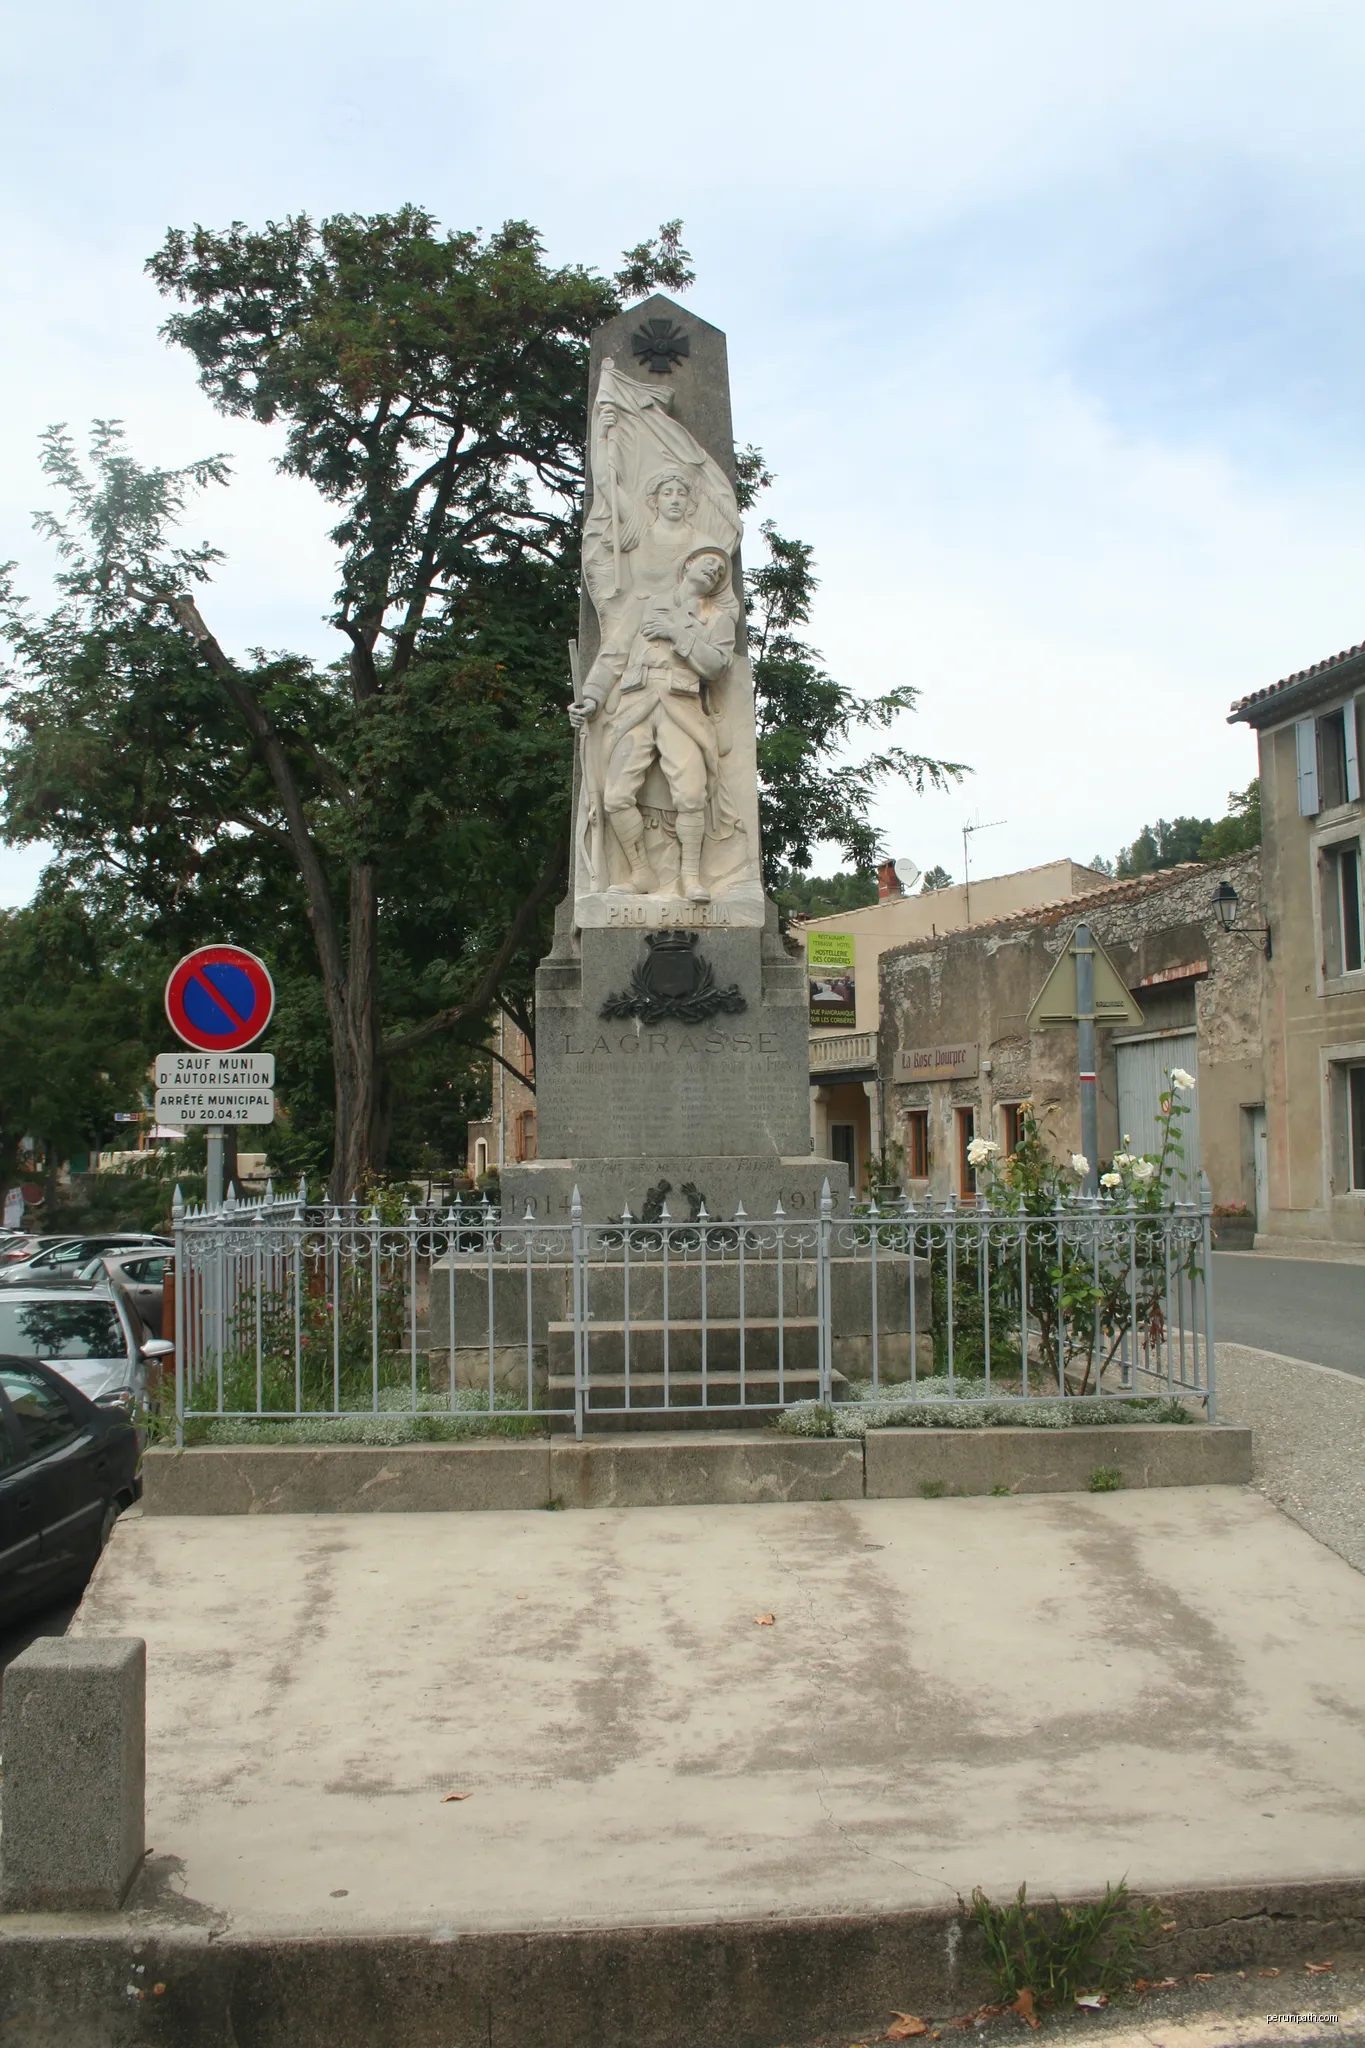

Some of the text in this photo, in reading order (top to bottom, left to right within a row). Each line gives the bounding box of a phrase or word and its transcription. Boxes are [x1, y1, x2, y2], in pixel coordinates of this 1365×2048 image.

[606, 903, 730, 925] PRO PATRIA
[815, 949, 848, 957] HOSTELLERIE
[564, 1033, 778, 1055] LAGRASSE
[177, 1059, 254, 1070] SAUF MUNI
[901, 1053, 911, 1069] La
[935, 1049, 966, 1067] Pourpre
[160, 1073, 270, 1084] D'AUTORISATION
[160, 1094, 270, 1105] ARRÊTÉ MUNICIPAL
[181, 1110, 248, 1119] DU 20.04.12
